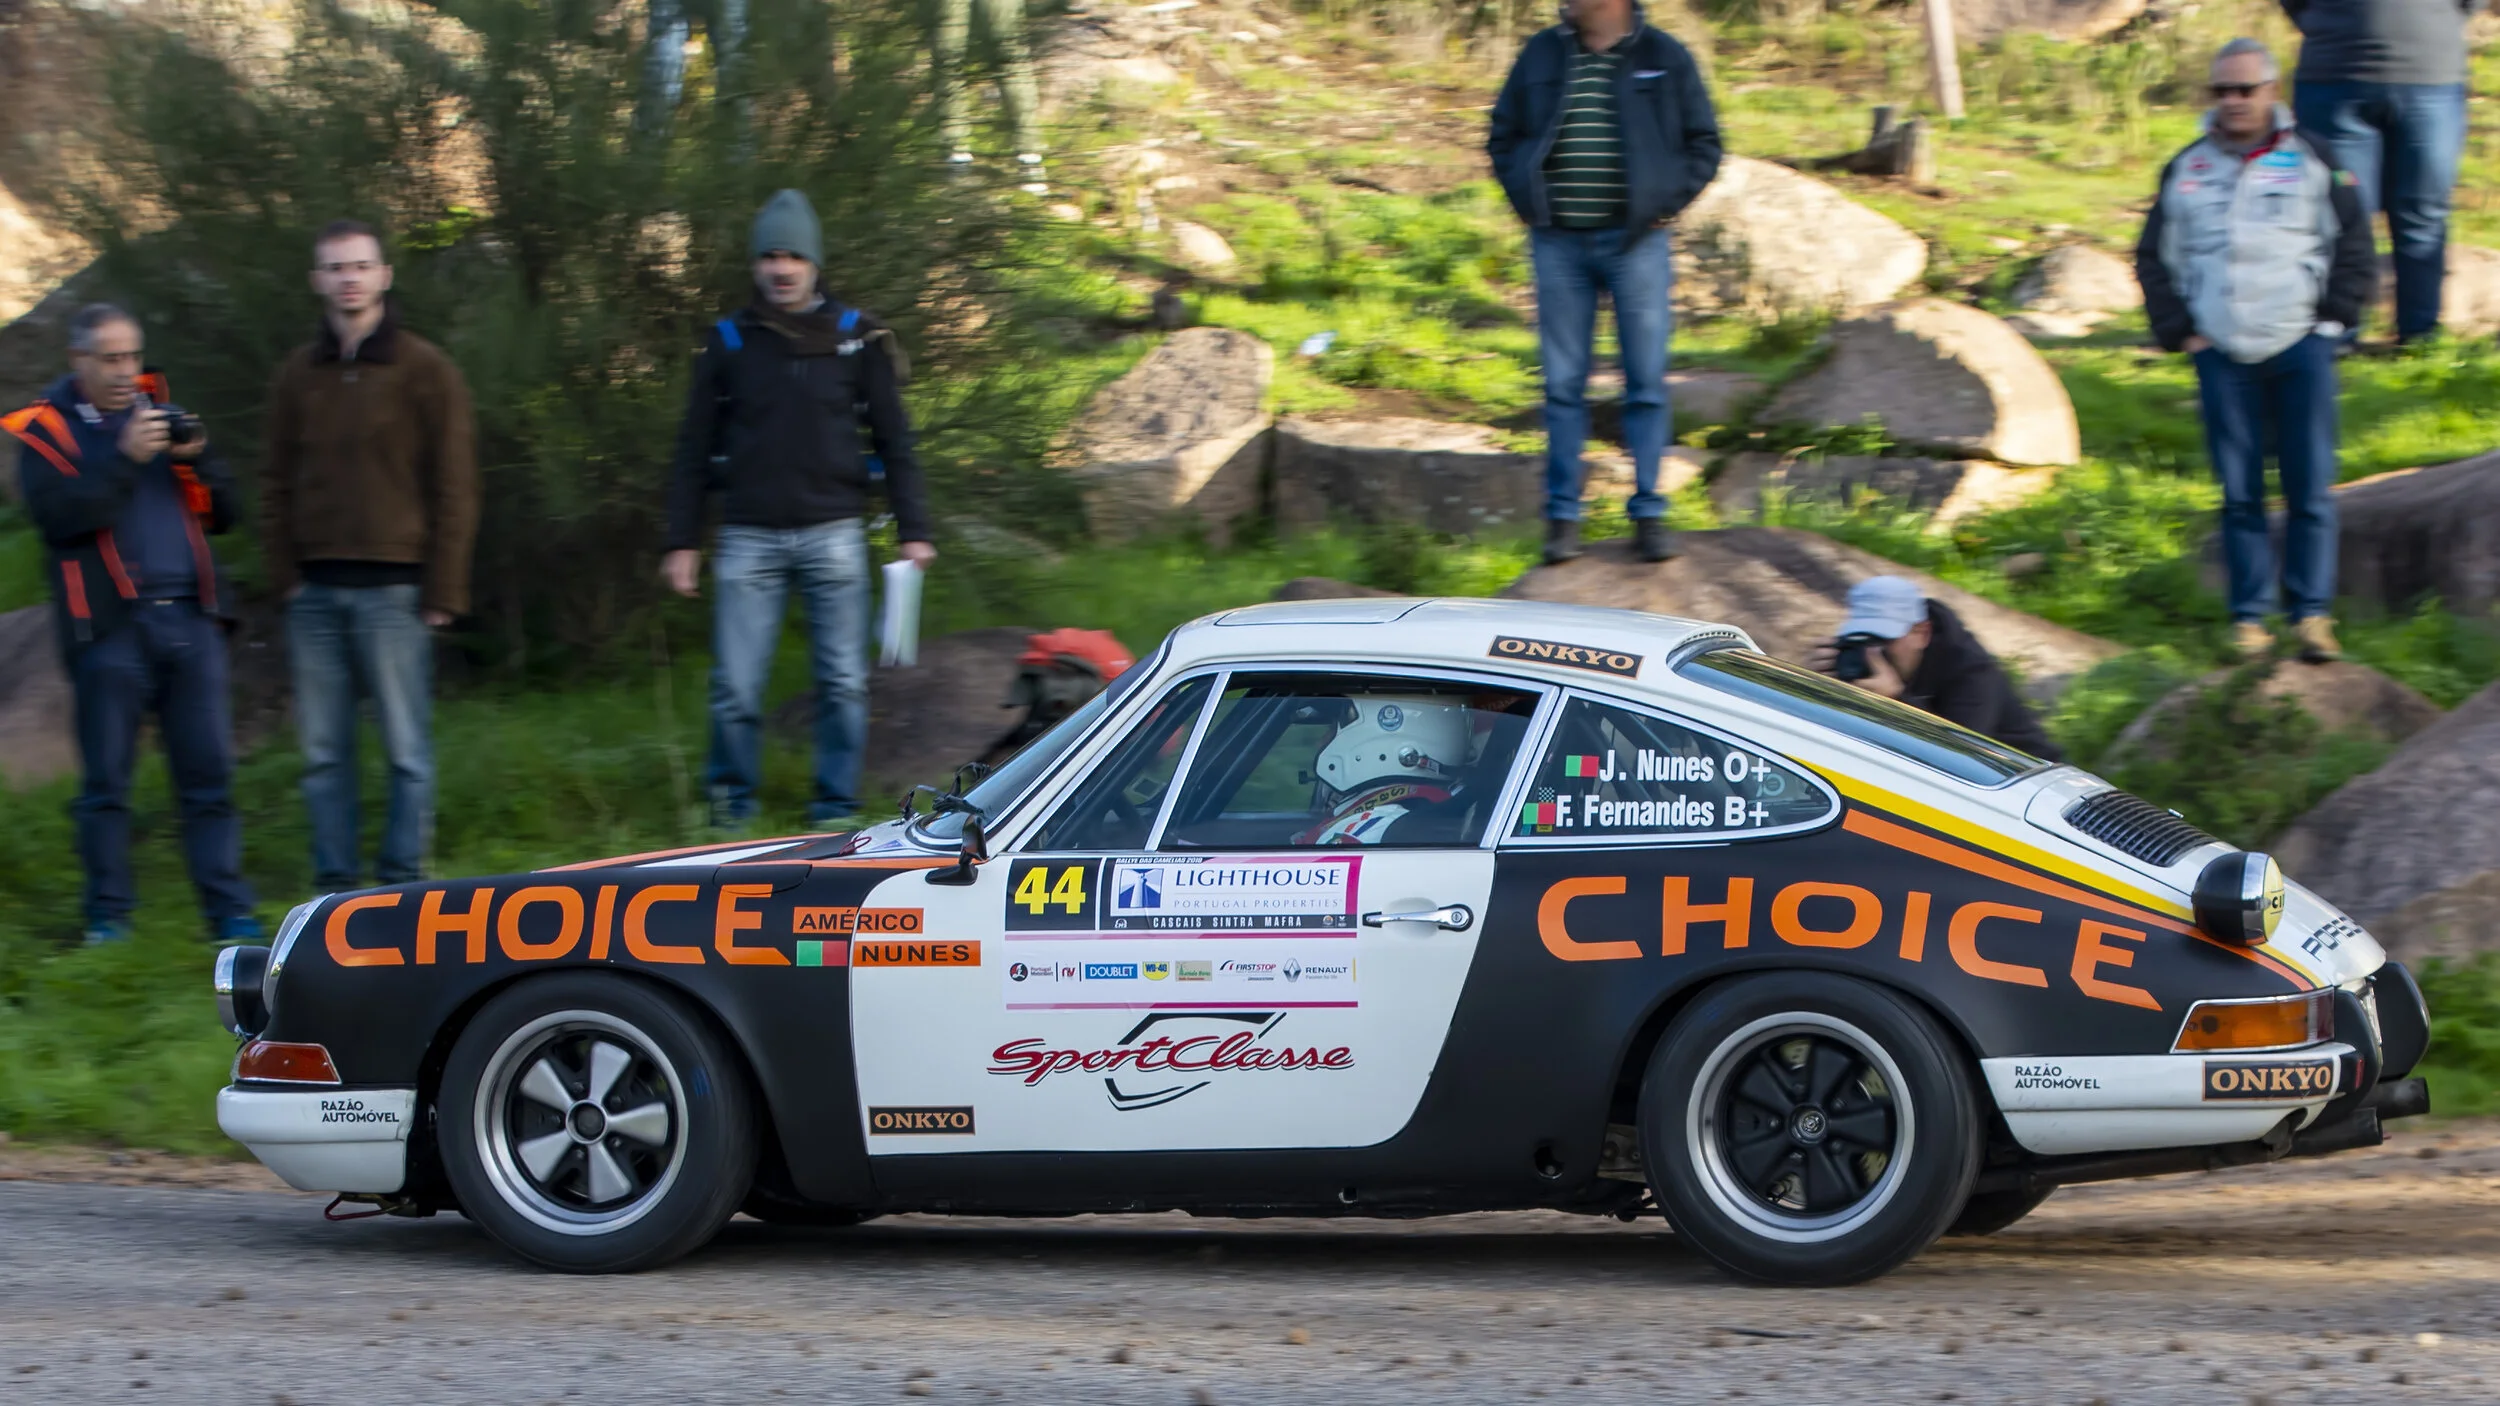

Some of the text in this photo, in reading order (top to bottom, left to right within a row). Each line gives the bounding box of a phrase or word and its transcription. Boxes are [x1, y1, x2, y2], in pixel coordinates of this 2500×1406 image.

[1498, 639, 1636, 671] ONKYO
[1600, 750, 1771, 783] J. Nunes O+
[1556, 795, 1770, 827] F. Fernandes B+
[1176, 868, 1341, 887] LIGHTHOUSE
[1014, 866, 1086, 915] 44
[1174, 898, 1339, 909] PORTUGAL PROPERTIES
[324, 883, 792, 967] CHOICE
[800, 909, 919, 931] AMÉRICO
[1153, 915, 1302, 928] CASCAIS SINTRA MAFRA
[861, 944, 970, 962] NUNES
[1537, 876, 2163, 1012] CHOICE
[1089, 966, 1134, 977] DOUBLET
[1305, 966, 1348, 974] RENAULT
[2015, 1063, 2062, 1076] RAZÃO
[2015, 1076, 2101, 1089] AUTOMÓVEL
[2210, 1067, 2332, 1093] ONKYO
[321, 1098, 364, 1111] RAZÃO
[322, 1109, 399, 1122] AUTOMÓVEL
[874, 1112, 970, 1129] ONKYO
